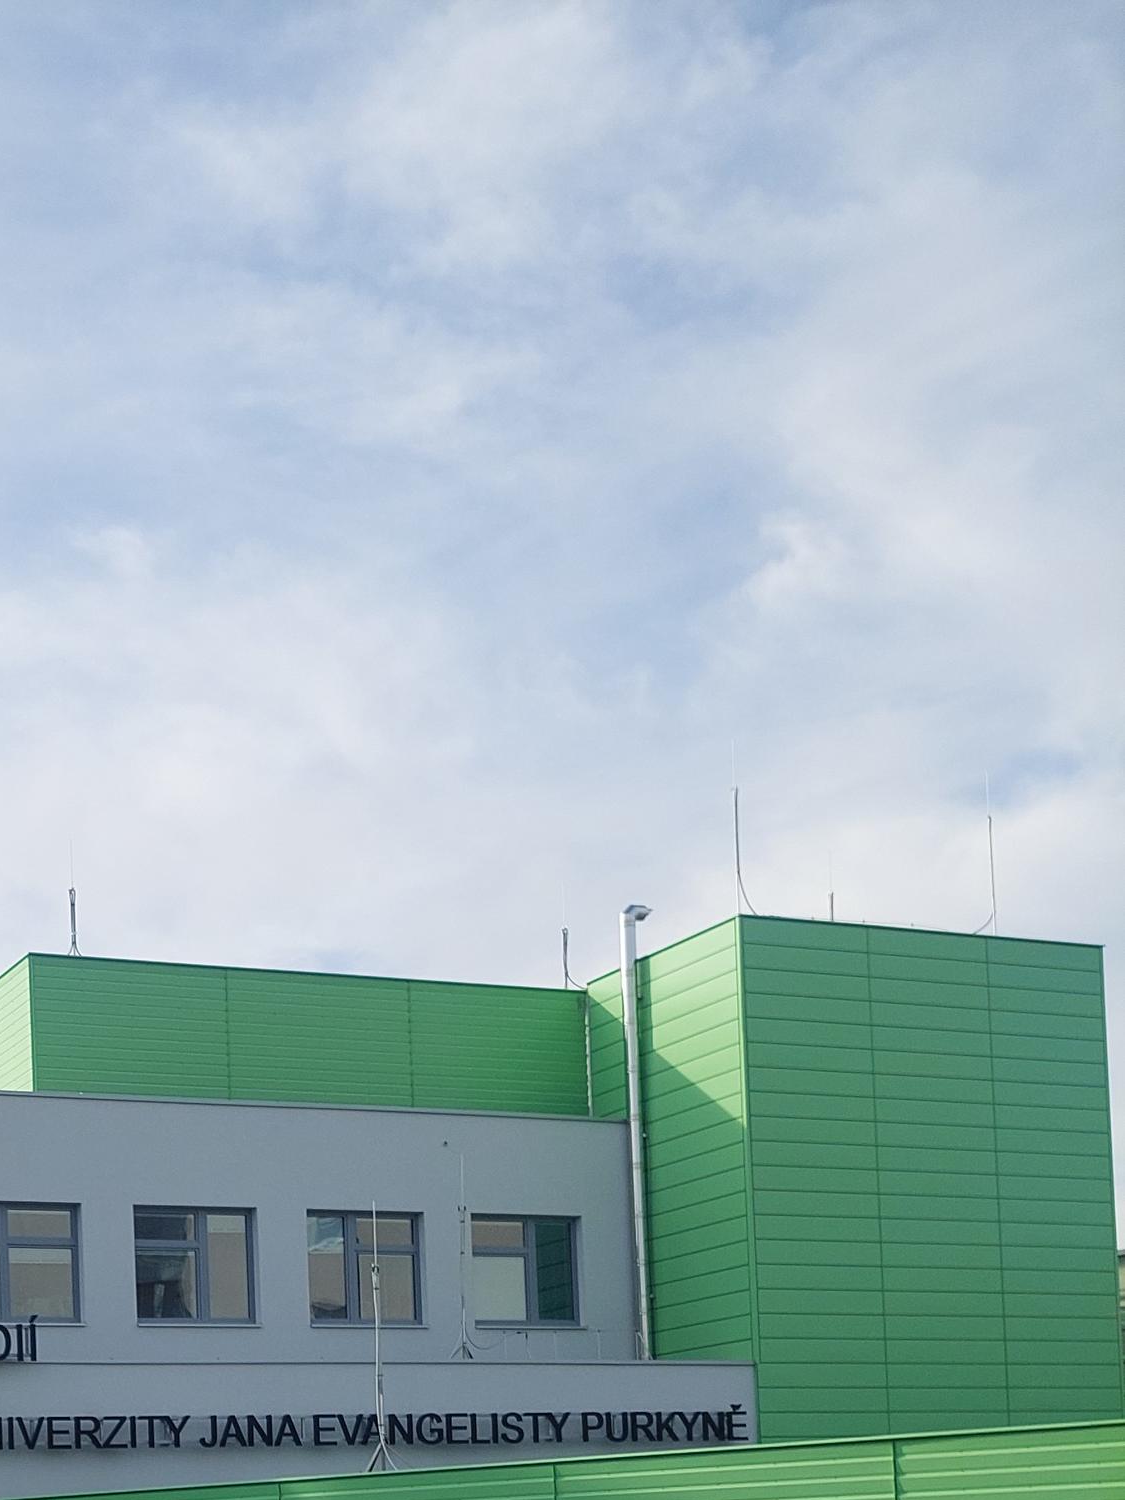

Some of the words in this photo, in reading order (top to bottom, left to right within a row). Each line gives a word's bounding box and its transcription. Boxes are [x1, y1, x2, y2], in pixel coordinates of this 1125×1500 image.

[199, 1414, 303, 1448] JANA
[312, 1412, 569, 1446] EVANGELISTY
[581, 1404, 750, 1442] PURKYNĚ
